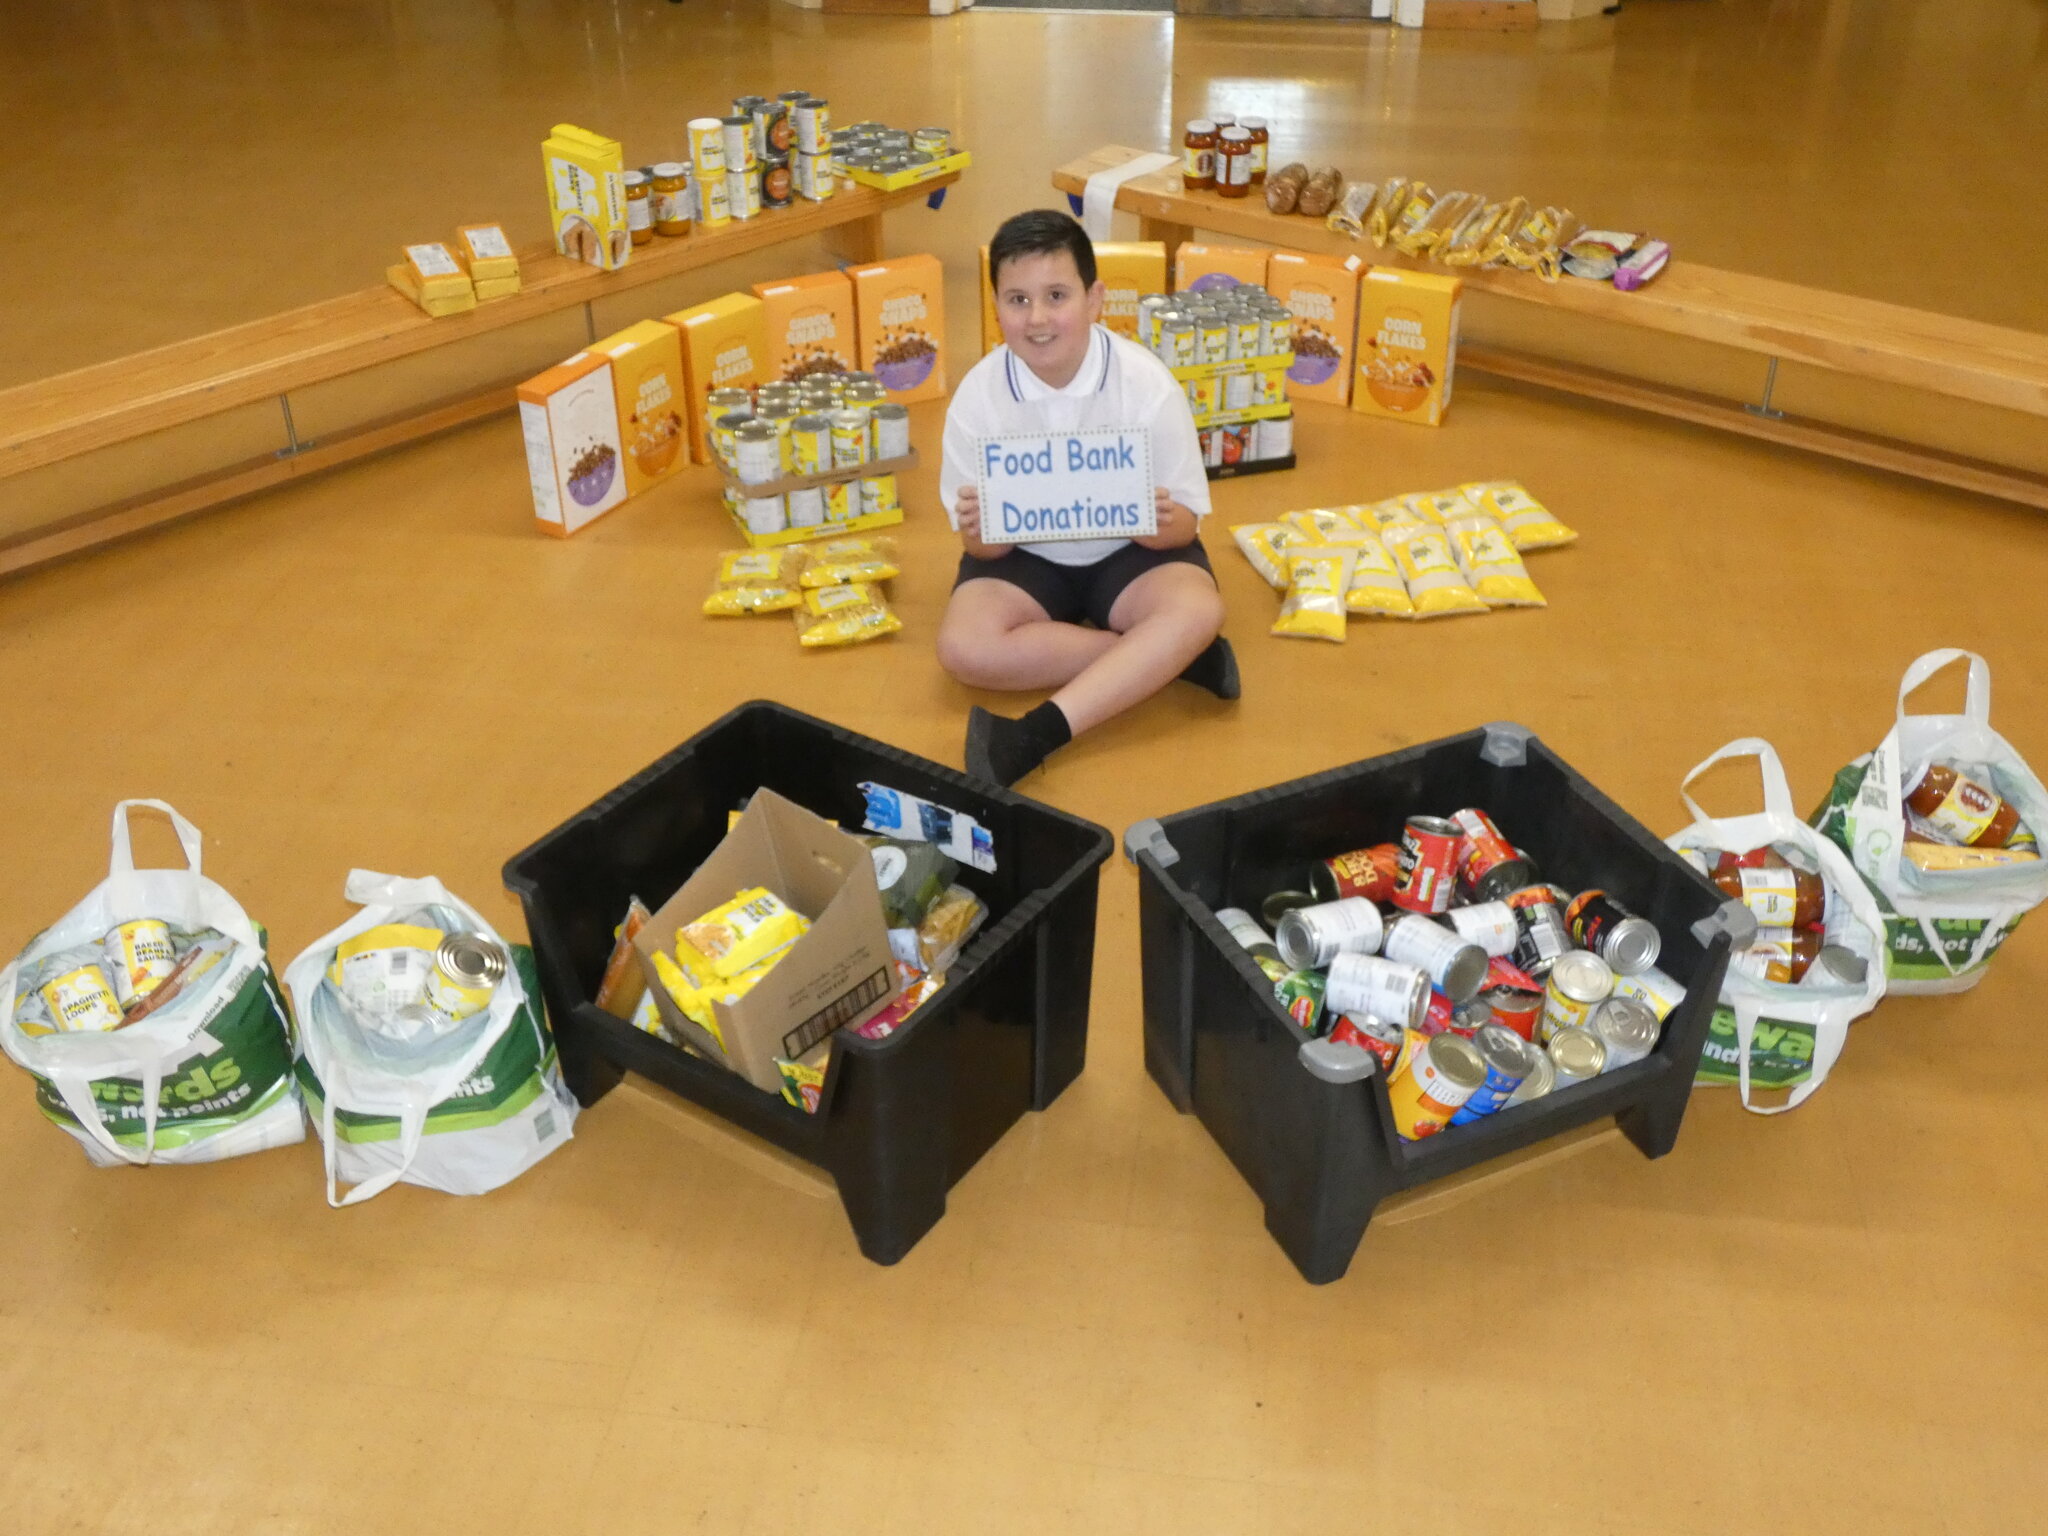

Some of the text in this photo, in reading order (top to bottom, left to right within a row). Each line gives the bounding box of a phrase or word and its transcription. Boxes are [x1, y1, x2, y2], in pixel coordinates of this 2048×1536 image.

[1377, 329, 1427, 350] FLAKES
[1384, 317, 1422, 335] CORN
[985, 435, 1135, 478] Food Bank
[1002, 497, 1140, 534] Donations
[66, 1003, 98, 1022] LOOPS
[171, 1083, 252, 1118] points
